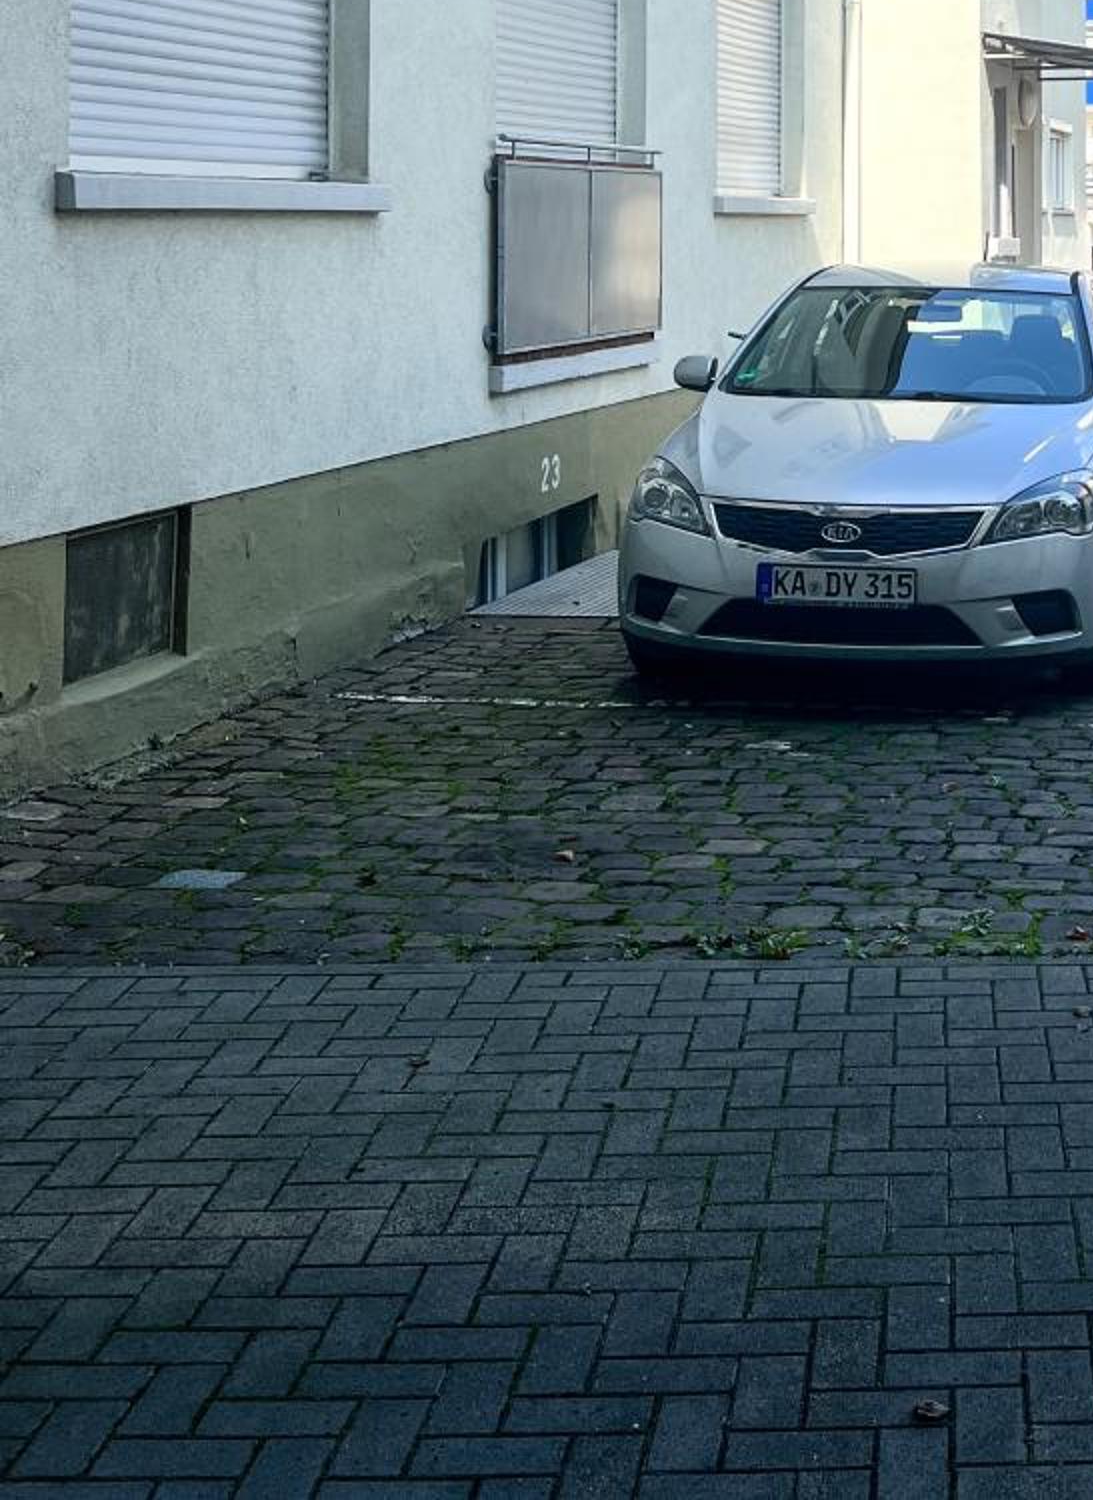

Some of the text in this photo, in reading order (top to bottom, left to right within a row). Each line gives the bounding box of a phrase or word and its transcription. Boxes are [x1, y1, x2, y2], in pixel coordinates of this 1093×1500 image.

[541, 453, 561, 493] 23
[774, 570, 913, 599] KA DY 315
